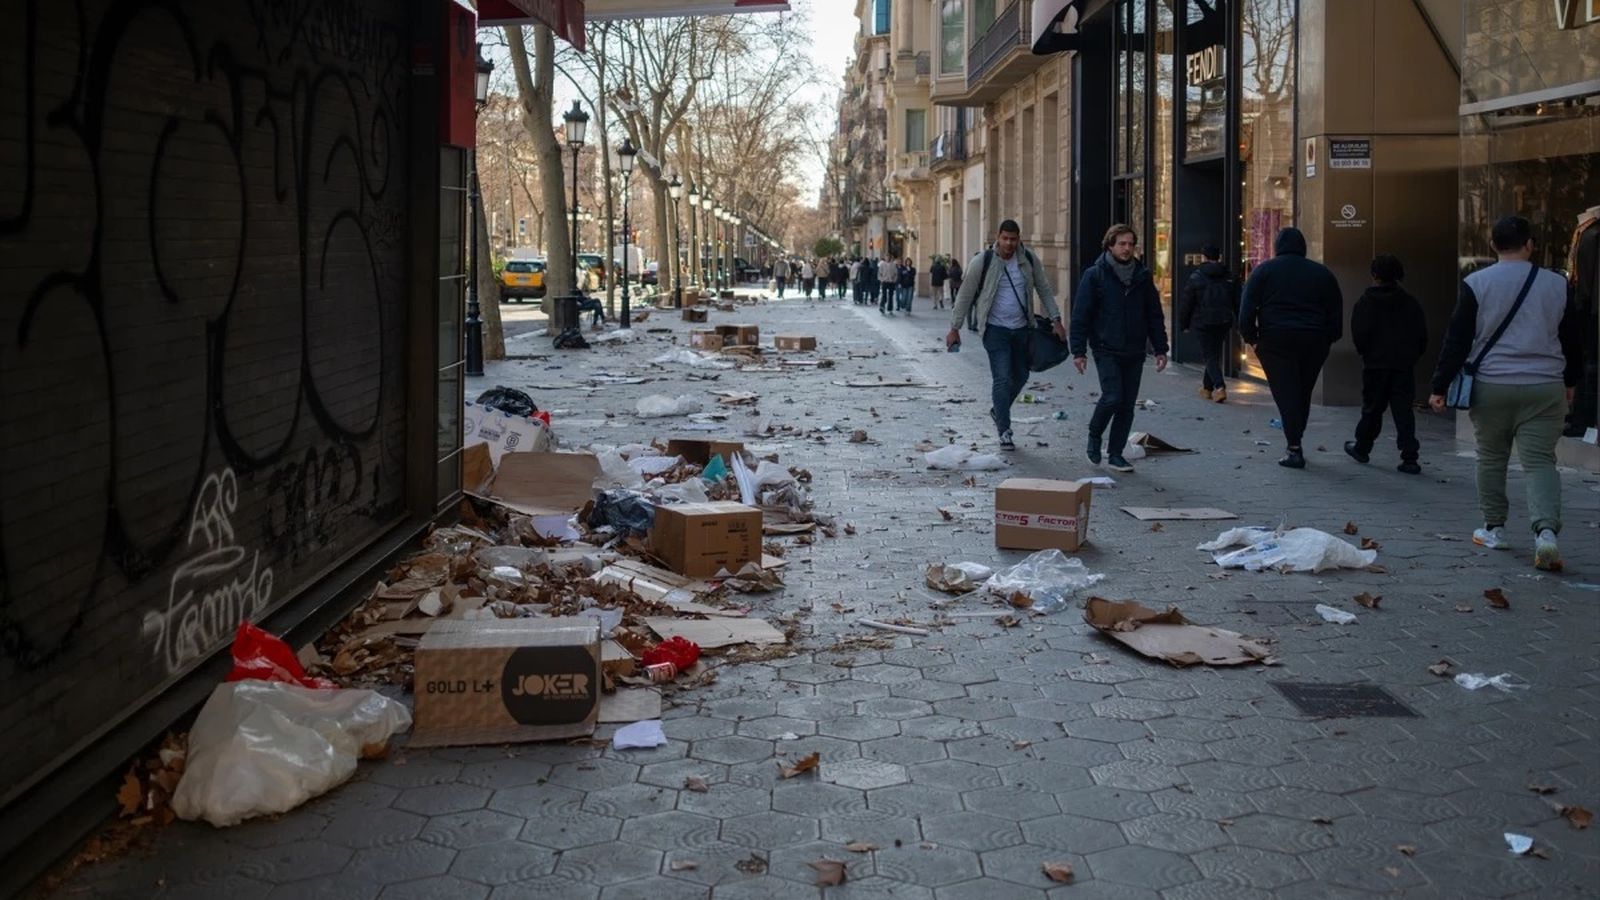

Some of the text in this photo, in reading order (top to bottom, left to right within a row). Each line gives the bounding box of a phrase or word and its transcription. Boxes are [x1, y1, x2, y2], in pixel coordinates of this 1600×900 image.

[1186, 44, 1217, 86] FENDI
[426, 679, 494, 694] GOLD L+
[512, 673, 589, 696] JOKER
